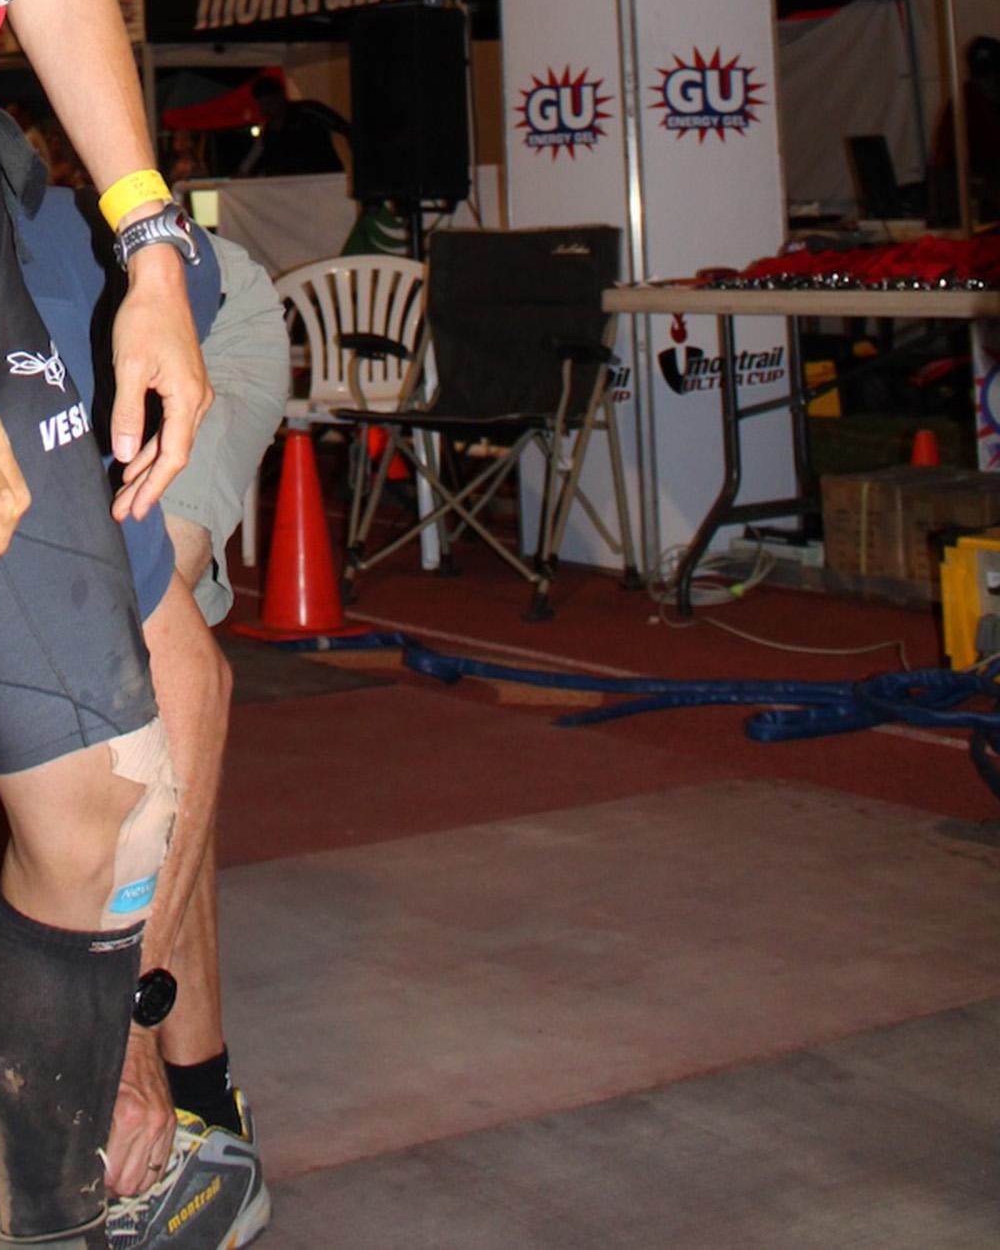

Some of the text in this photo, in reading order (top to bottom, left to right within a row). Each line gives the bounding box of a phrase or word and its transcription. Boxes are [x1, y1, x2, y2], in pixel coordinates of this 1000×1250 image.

[527, 82, 596, 133] GU
[665, 67, 746, 115] GU
[528, 131, 596, 147] ENERGY GEL
[667, 114, 746, 129] ENERGY GEL
[746, 369, 784, 386] CUP
[40, 401, 90, 452] VES
[167, 1173, 222, 1235] montrail
